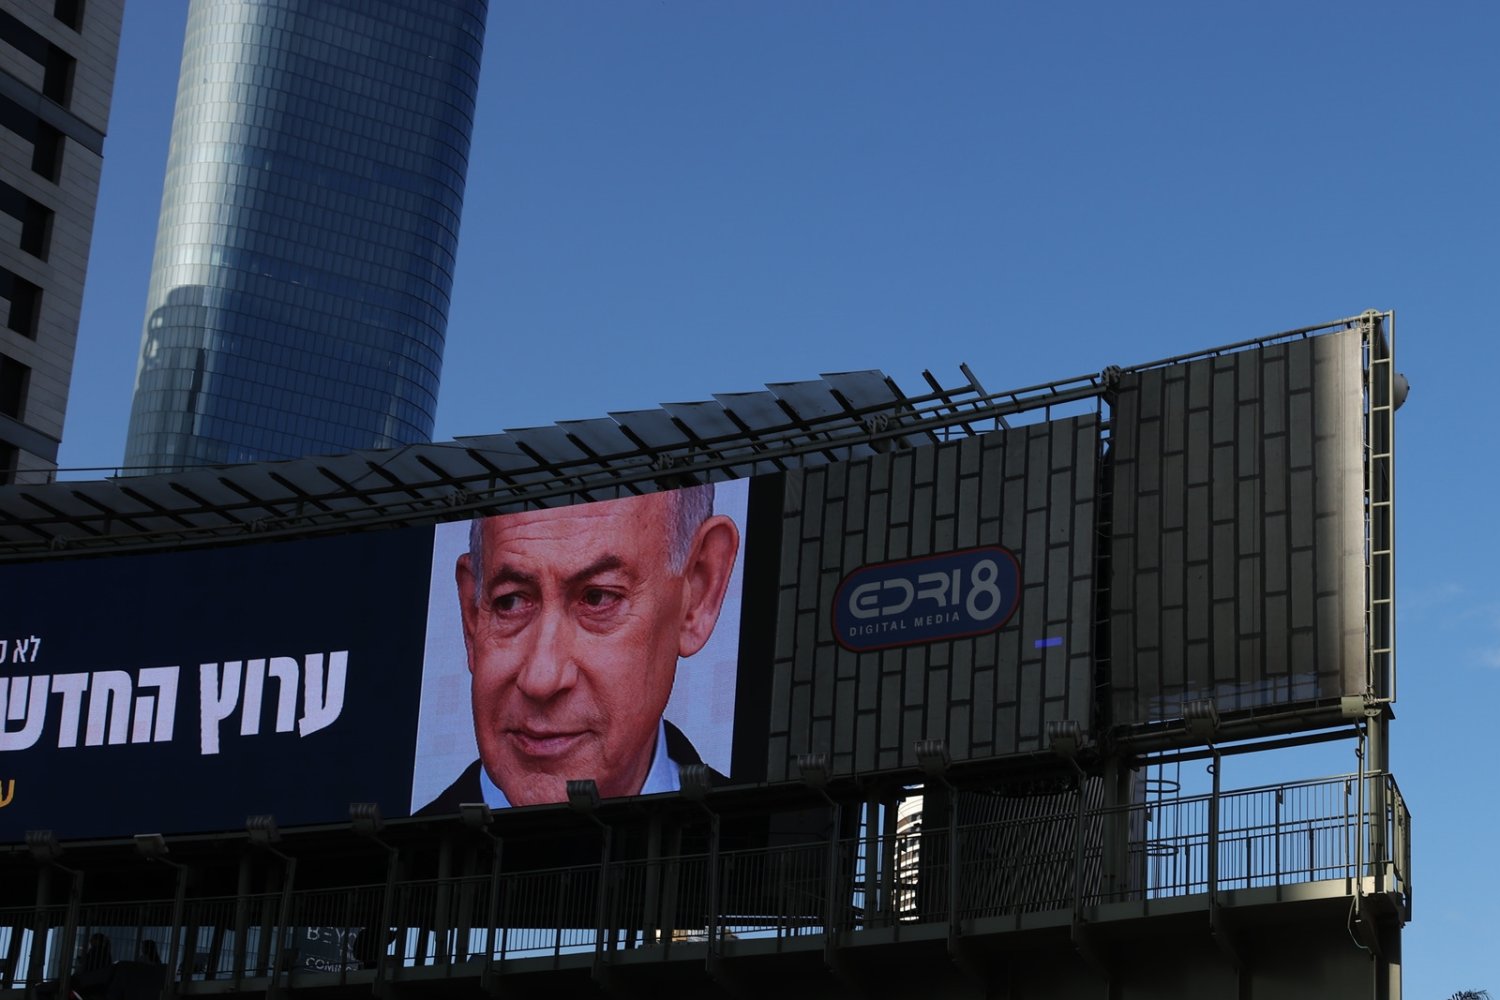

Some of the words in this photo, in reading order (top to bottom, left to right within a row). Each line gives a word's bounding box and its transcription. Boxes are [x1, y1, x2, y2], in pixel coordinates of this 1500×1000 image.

[850, 620, 907, 637] DIGITAL
[914, 611, 960, 627] MEDIA
[12, 635, 41, 663] לא
[198, 650, 349, 755] ערוץ
